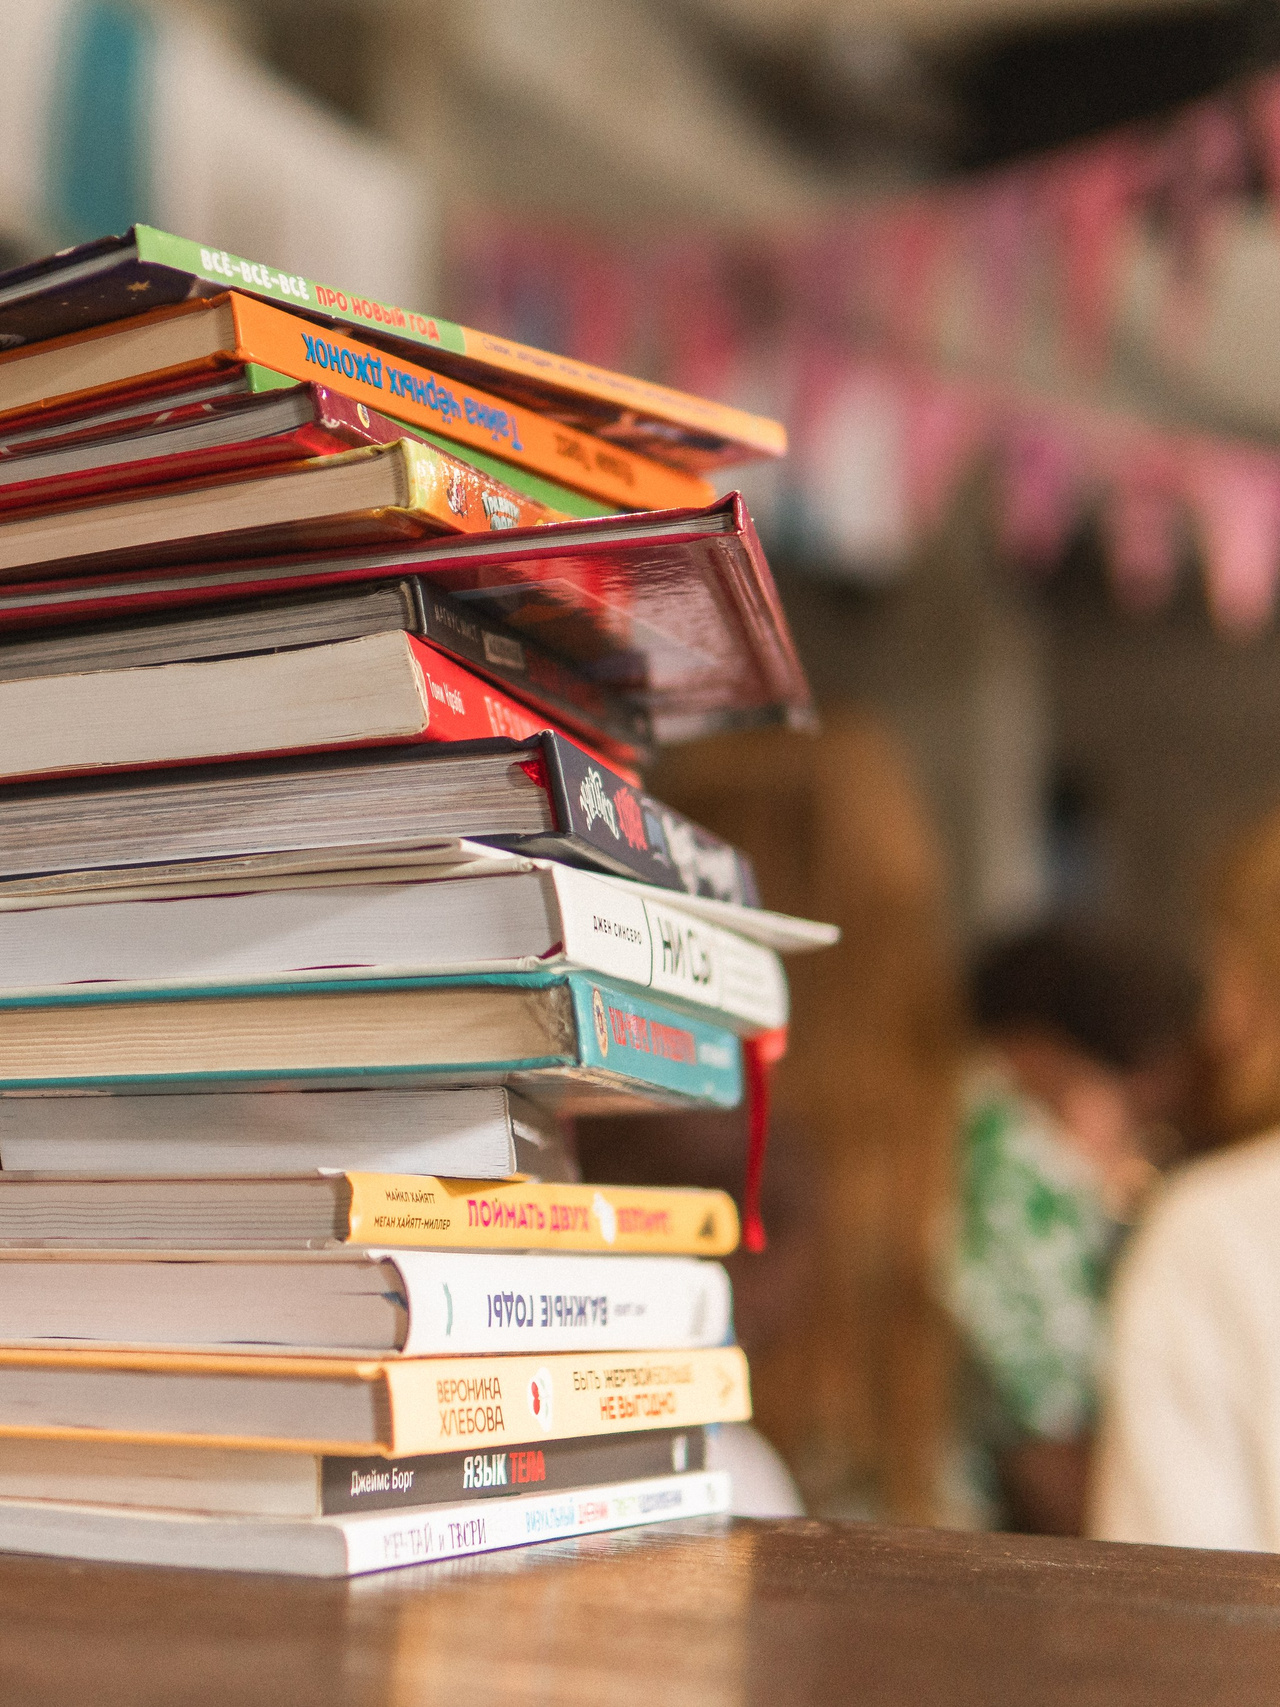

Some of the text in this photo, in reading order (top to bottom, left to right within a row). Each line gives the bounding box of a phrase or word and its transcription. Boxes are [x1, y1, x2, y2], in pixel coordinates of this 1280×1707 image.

[200, 248, 440, 341] ВСЁ-ВСЁ-ВСЁ ПРО НОВЫЙ ГОД
[388, 365, 461, 423] чёрных
[464, 397, 523, 451] Тайна
[593, 915, 643, 945] ДЖЕН СИНСЕРО
[385, 1189, 435, 1204] МАЙКЛ ХАЙЯТТ
[374, 1215, 451, 1231] МЕГАН ХАЙЯТТ-МИЛЛЕР
[467, 1198, 546, 1230] ПОЙМАТЬ
[550, 1205, 590, 1232] ДВУХ
[487, 1291, 607, 1328] ВАЖНЫЕ ГОДЫ
[436, 1377, 502, 1404] ВЕРОНИКА
[573, 1370, 601, 1391] БЫТЬ
[439, 1405, 505, 1436] ХЛЕБОВА
[600, 1392, 676, 1420] НЕ ВЫГОДНО
[351, 1468, 414, 1496] Джеймс Борг
[463, 1450, 546, 1489] ЯЗЫК ТЕЛА
[448, 1518, 486, 1549] ТВОРИ
